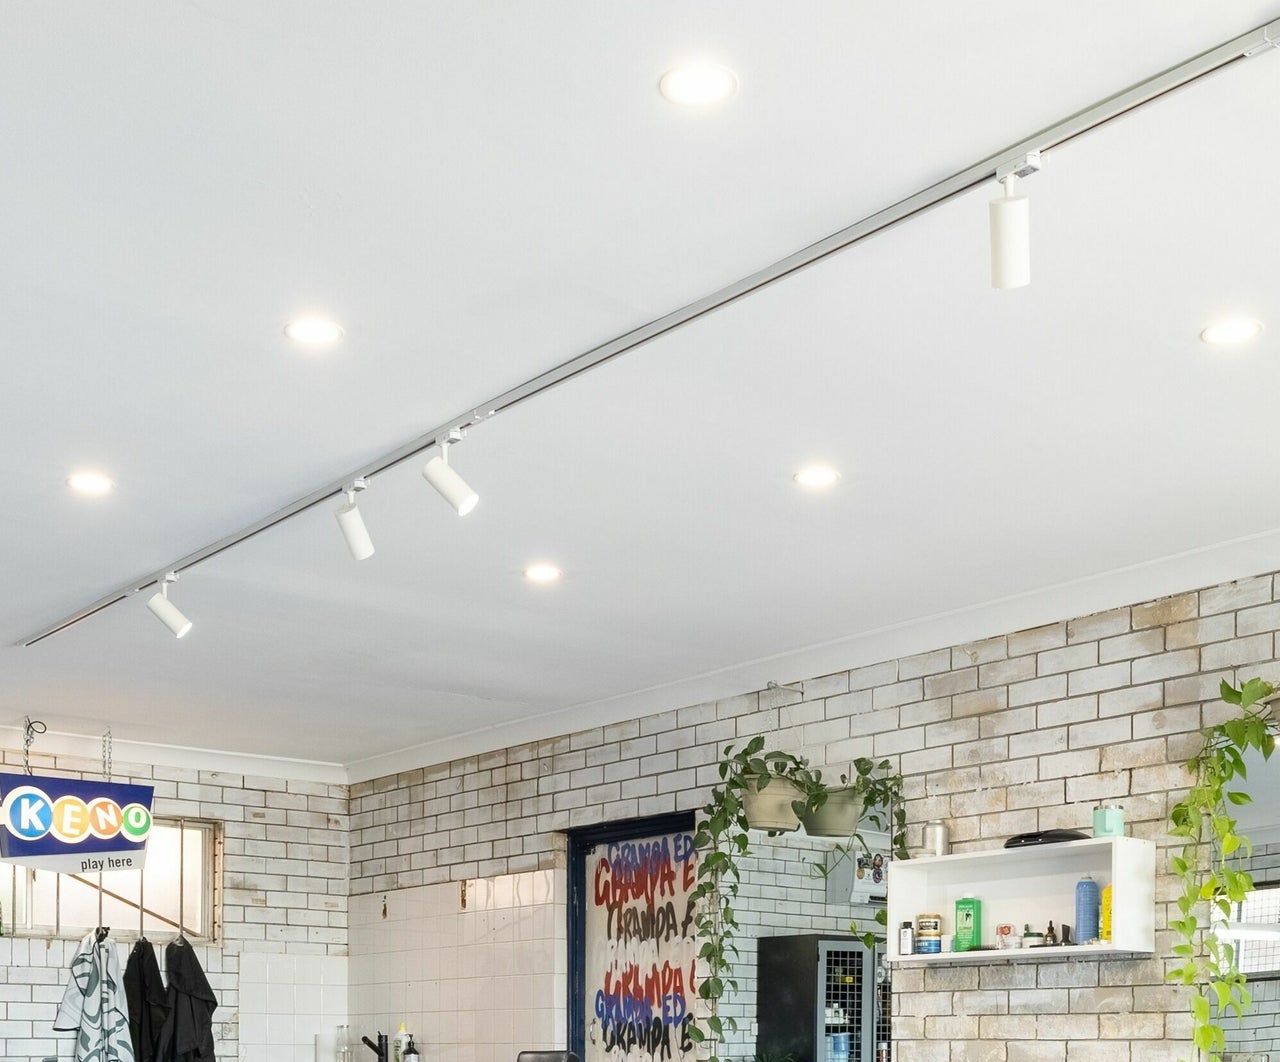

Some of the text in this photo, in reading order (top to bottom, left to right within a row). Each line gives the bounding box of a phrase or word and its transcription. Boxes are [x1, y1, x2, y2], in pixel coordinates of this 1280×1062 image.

[20, 797, 147, 835] KENO
[81, 857, 133, 872] play here
